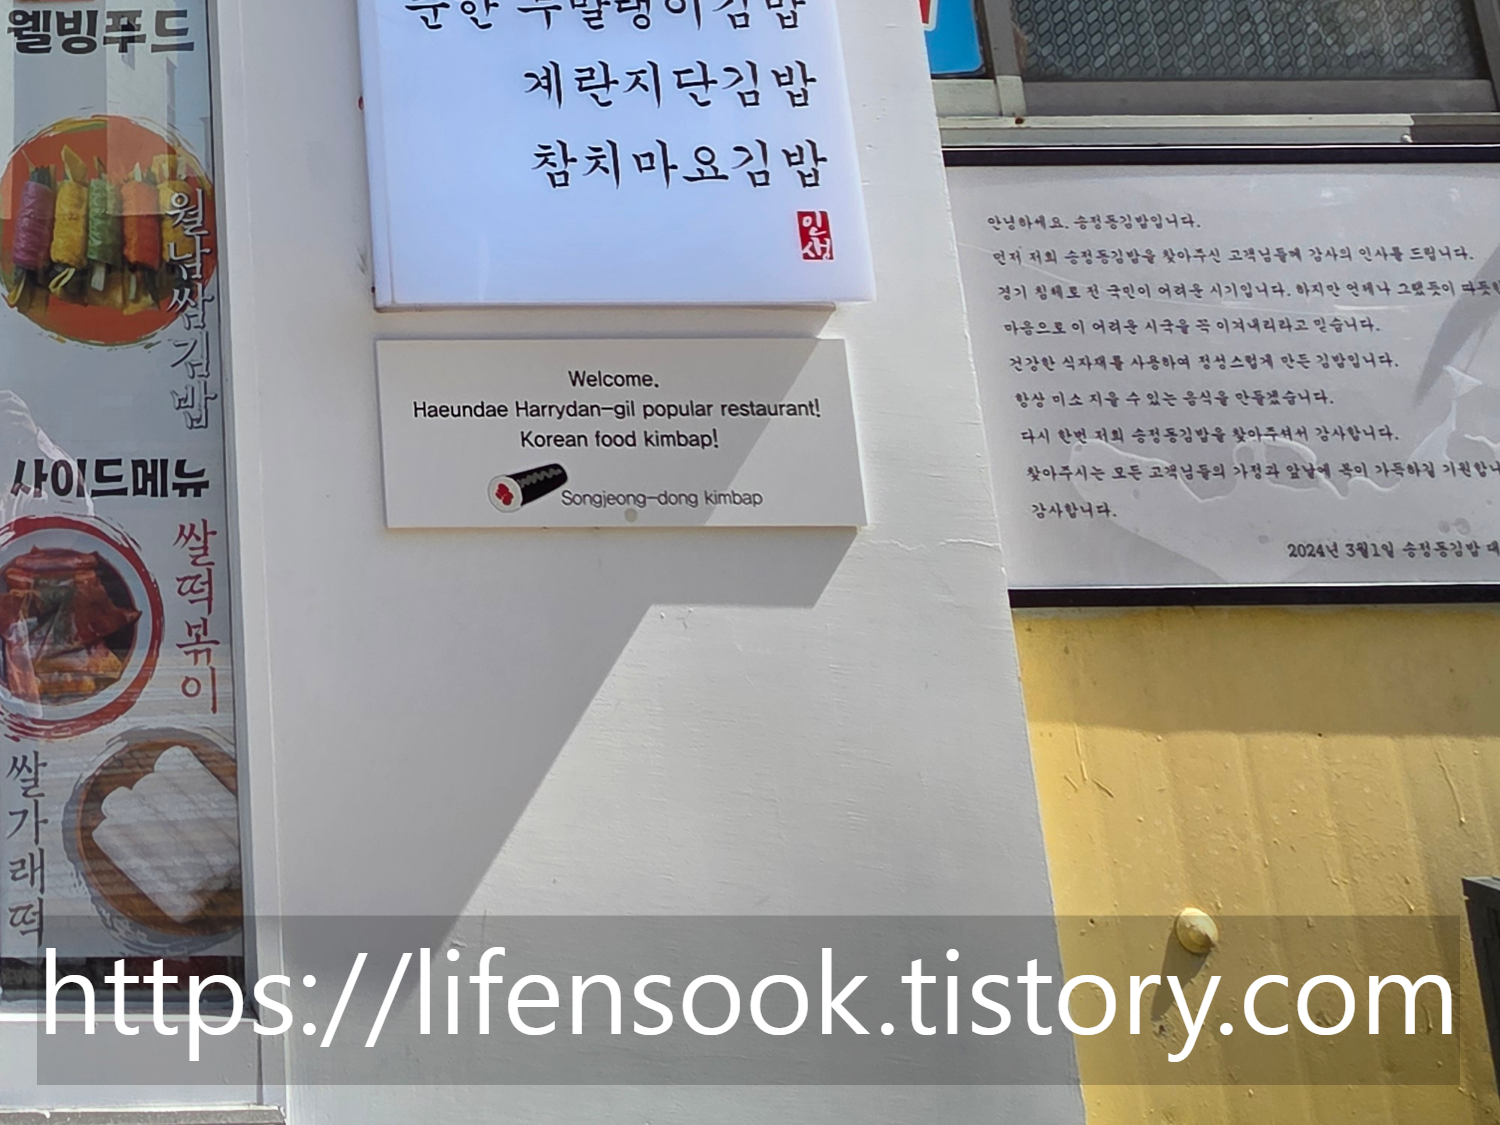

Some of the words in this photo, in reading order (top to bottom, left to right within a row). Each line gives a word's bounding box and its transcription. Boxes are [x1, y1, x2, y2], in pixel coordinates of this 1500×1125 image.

[7, 9, 195, 54] 웰빙푸드
[524, 60, 817, 109] 계란지단김밥
[532, 139, 828, 189] 참치마요김밥
[988, 214, 1069, 231] 안녕하세요.
[1074, 213, 1201, 231] 송정동김밥입니다.
[801, 213, 833, 260] 인생
[993, 249, 1022, 266] 먼저
[1029, 249, 1057, 265] 저희
[1064, 249, 1156, 265] 송정동김밥을
[1163, 248, 1221, 264] 찾아주신
[1309, 246, 1352, 262] 감사의
[1358, 246, 1404, 262] 인사를
[1410, 245, 1474, 262] 드립니다.
[998, 283, 1027, 301] 경기
[1035, 283, 1082, 300] 침체로
[1086, 283, 1100, 300] 전
[1106, 283, 1151, 300] 국민이
[1157, 282, 1204, 299] 어려운
[1210, 281, 1291, 299] 시기입니다.
[1296, 281, 1341, 298] 하지만
[1346, 281, 1391, 297] 언제나
[166, 188, 218, 431] 월남쌈김밥
[1004, 320, 1066, 335] 마음으로
[1072, 319, 1085, 334] 이
[1092, 318, 1138, 334] 어려운
[1145, 318, 1190, 334] 시국을
[1314, 317, 1380, 332] 믿습니다.
[1009, 355, 1056, 372] 건강한
[1062, 354, 1124, 371] 식자재를
[1131, 354, 1190, 371] 사용하여
[1198, 353, 1273, 370] 정성스럽게
[1281, 353, 1311, 369] 만든
[1317, 352, 1399, 368] 김밥입니다.
[568, 370, 660, 388] Welcome.
[1015, 391, 1045, 408] 항상
[1052, 391, 1083, 407] 미소
[1089, 391, 1119, 407] 지을
[1125, 391, 1140, 406] 수
[1146, 390, 1177, 406] 있는
[1183, 390, 1229, 407] 음식을
[1235, 389, 1334, 406] 만들겠습니다.
[413, 401, 508, 418] Haeundae
[515, 400, 637, 419] Harrydan-gil
[642, 399, 713, 419] popular
[720, 399, 821, 418] restaurant!
[520, 430, 588, 448] Korean
[594, 430, 637, 448] food
[643, 428, 719, 450] kimbap!
[1021, 428, 1049, 444] 다시
[1058, 428, 1087, 444] 한번
[1095, 427, 1124, 444] 저희
[1131, 427, 1226, 443] 송정동김밥을
[1233, 426, 1308, 442] 찾아주셔서
[1316, 425, 1399, 441] 감사합니다.
[10, 456, 210, 498] 사이드메뉴
[1027, 464, 1105, 481] 찾아주시는
[1112, 464, 1142, 480] 모든
[1149, 464, 1225, 480] 고객님들의
[1233, 462, 1279, 479] 가정과
[1338, 462, 1368, 478] 복이
[1376, 462, 1435, 478] 가득하길
[561, 489, 699, 508] Songjeong-dong
[704, 489, 764, 507] kimbap
[1031, 502, 1117, 519] 감사합니다.
[1287, 542, 1340, 559] 2024년
[1402, 541, 1481, 558] 송정동김밥
[173, 517, 221, 715] 쌀떡볶이
[6, 750, 48, 948] 쌀가래떡
